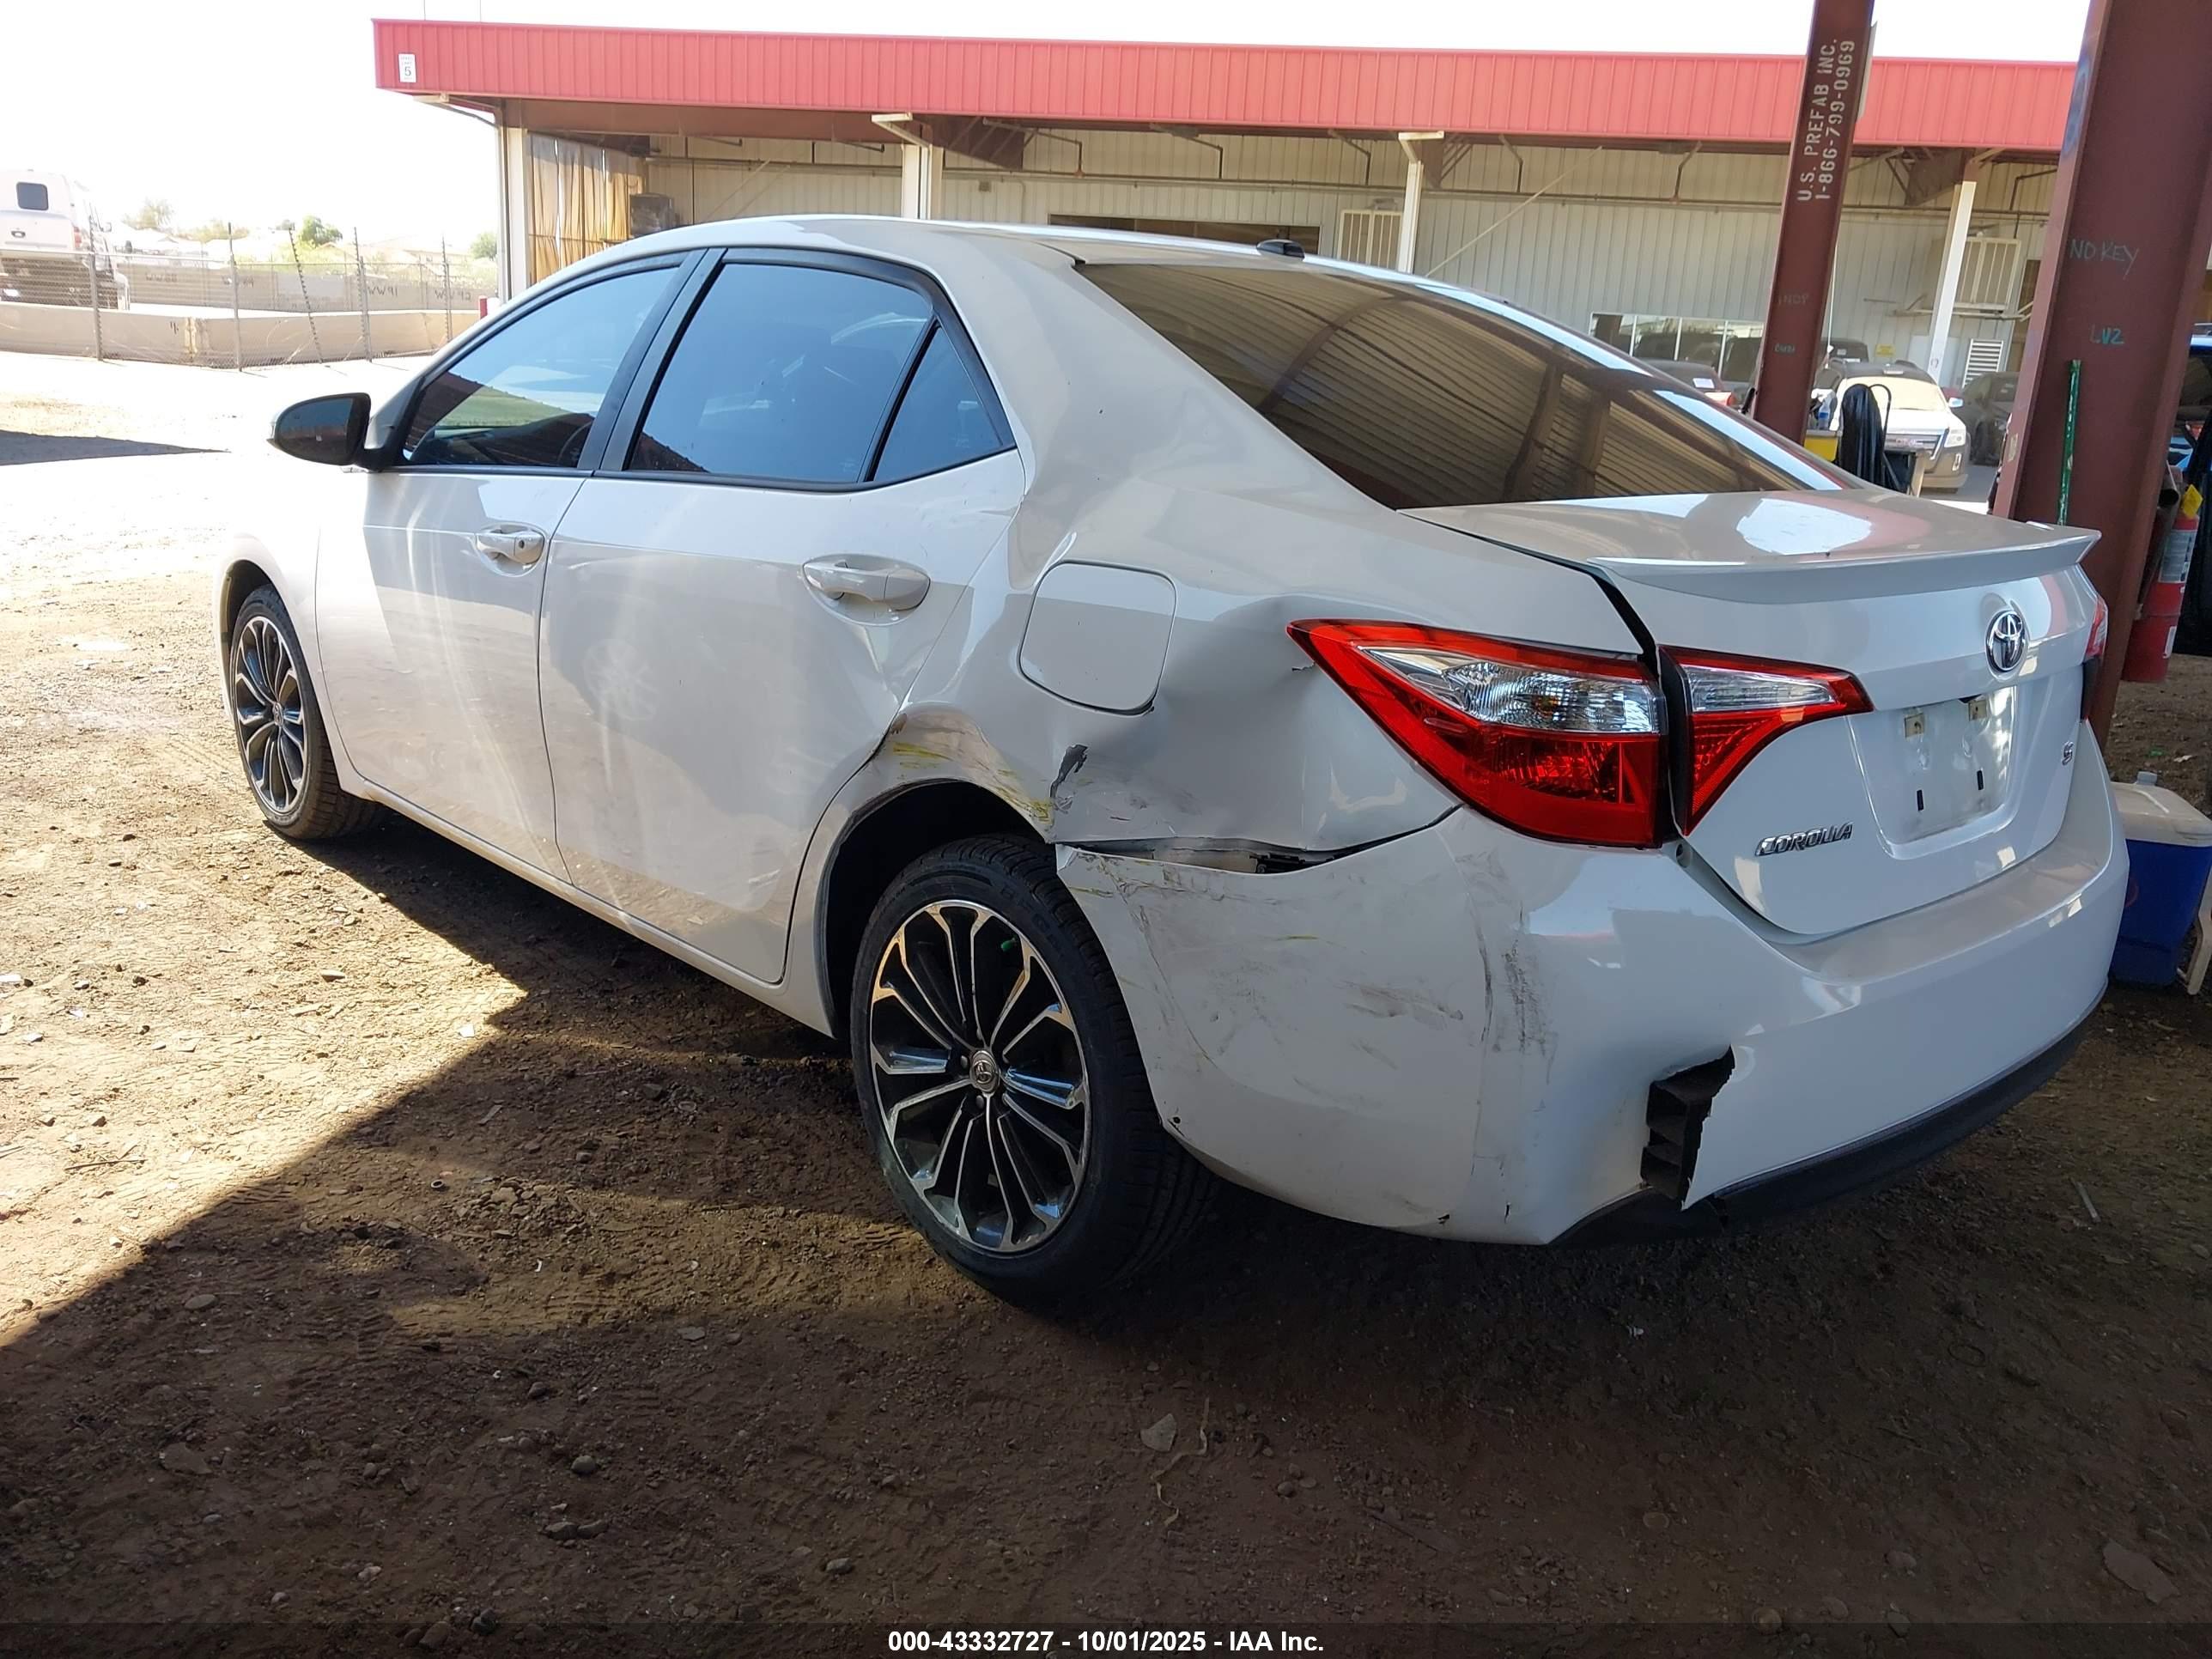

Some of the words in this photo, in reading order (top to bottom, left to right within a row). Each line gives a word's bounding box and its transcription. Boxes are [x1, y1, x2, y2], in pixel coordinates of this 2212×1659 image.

[404, 66, 411, 76] 5
[1817, 39, 1838, 75] INC.
[1804, 84, 1829, 156] PREFAB
[1815, 40, 1855, 199] 1-866-799-0969
[1797, 167, 1816, 202] U.S.
[2069, 239, 2096, 260] NO
[2100, 239, 2140, 281] KEY
[1754, 822, 1854, 857] COROLLA
